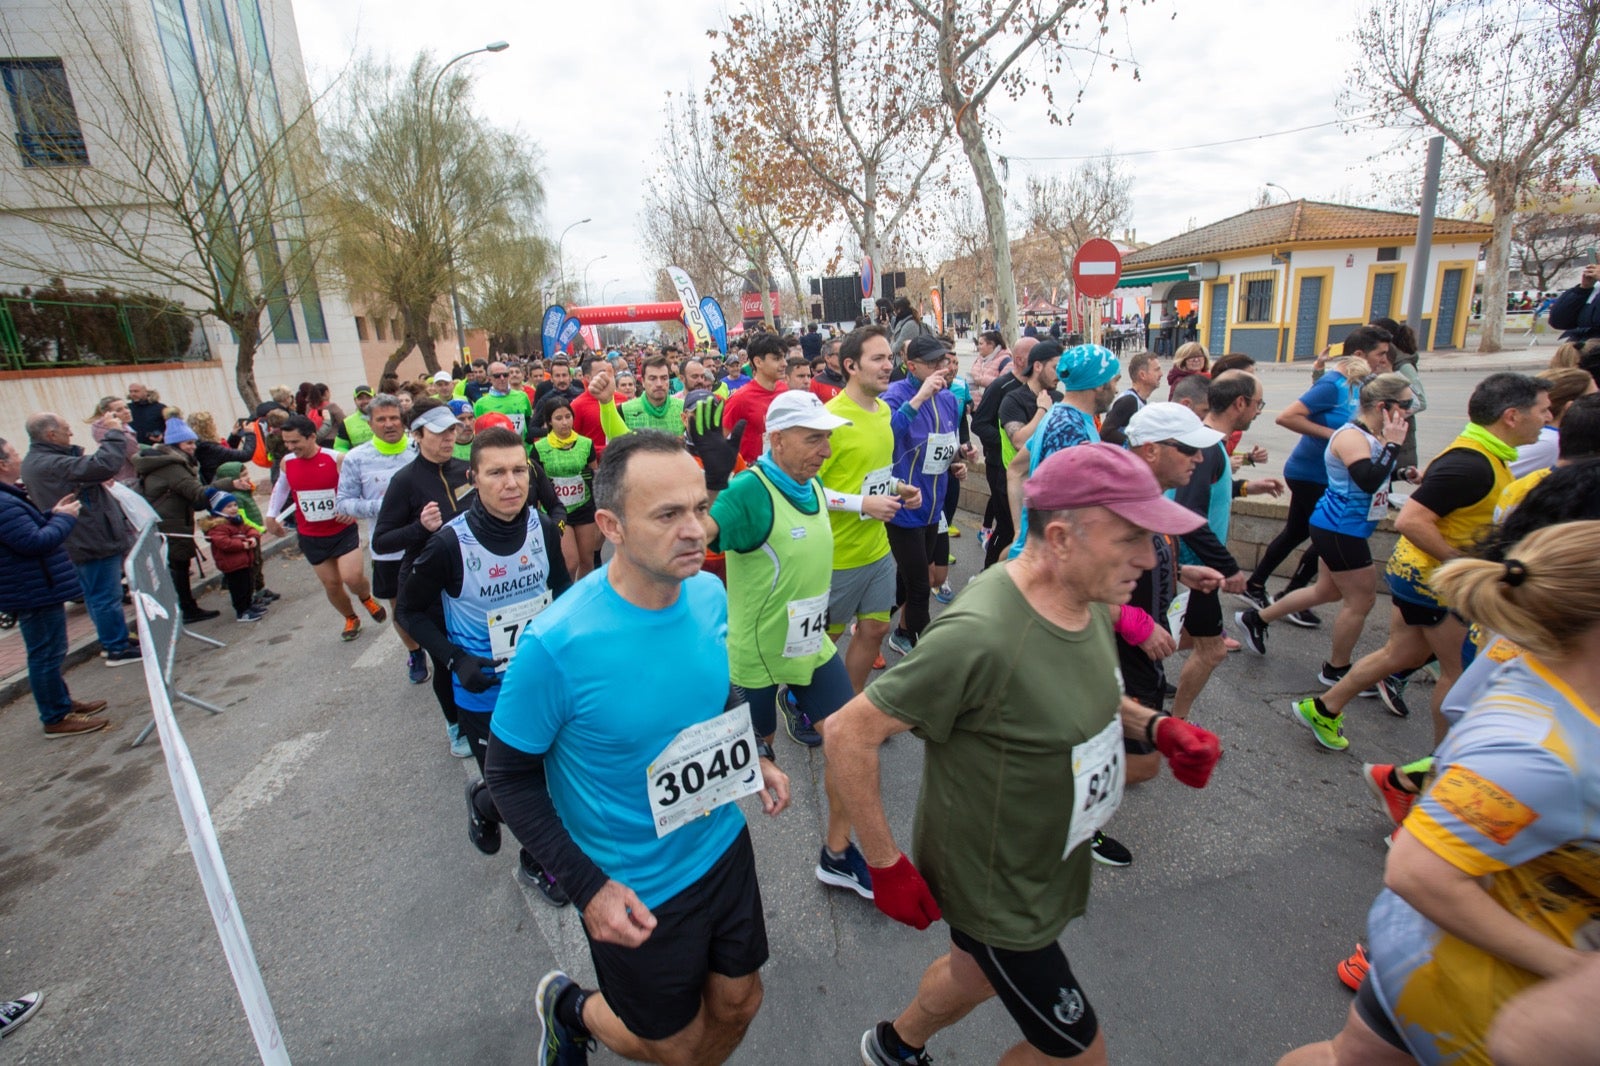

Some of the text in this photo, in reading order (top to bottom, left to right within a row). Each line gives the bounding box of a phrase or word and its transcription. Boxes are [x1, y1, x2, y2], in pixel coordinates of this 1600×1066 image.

[933, 445, 954, 461] 529
[555, 483, 584, 497] 2025
[300, 499, 334, 513] 3149
[479, 570, 544, 597] MARACENA
[655, 739, 751, 807] 3040
